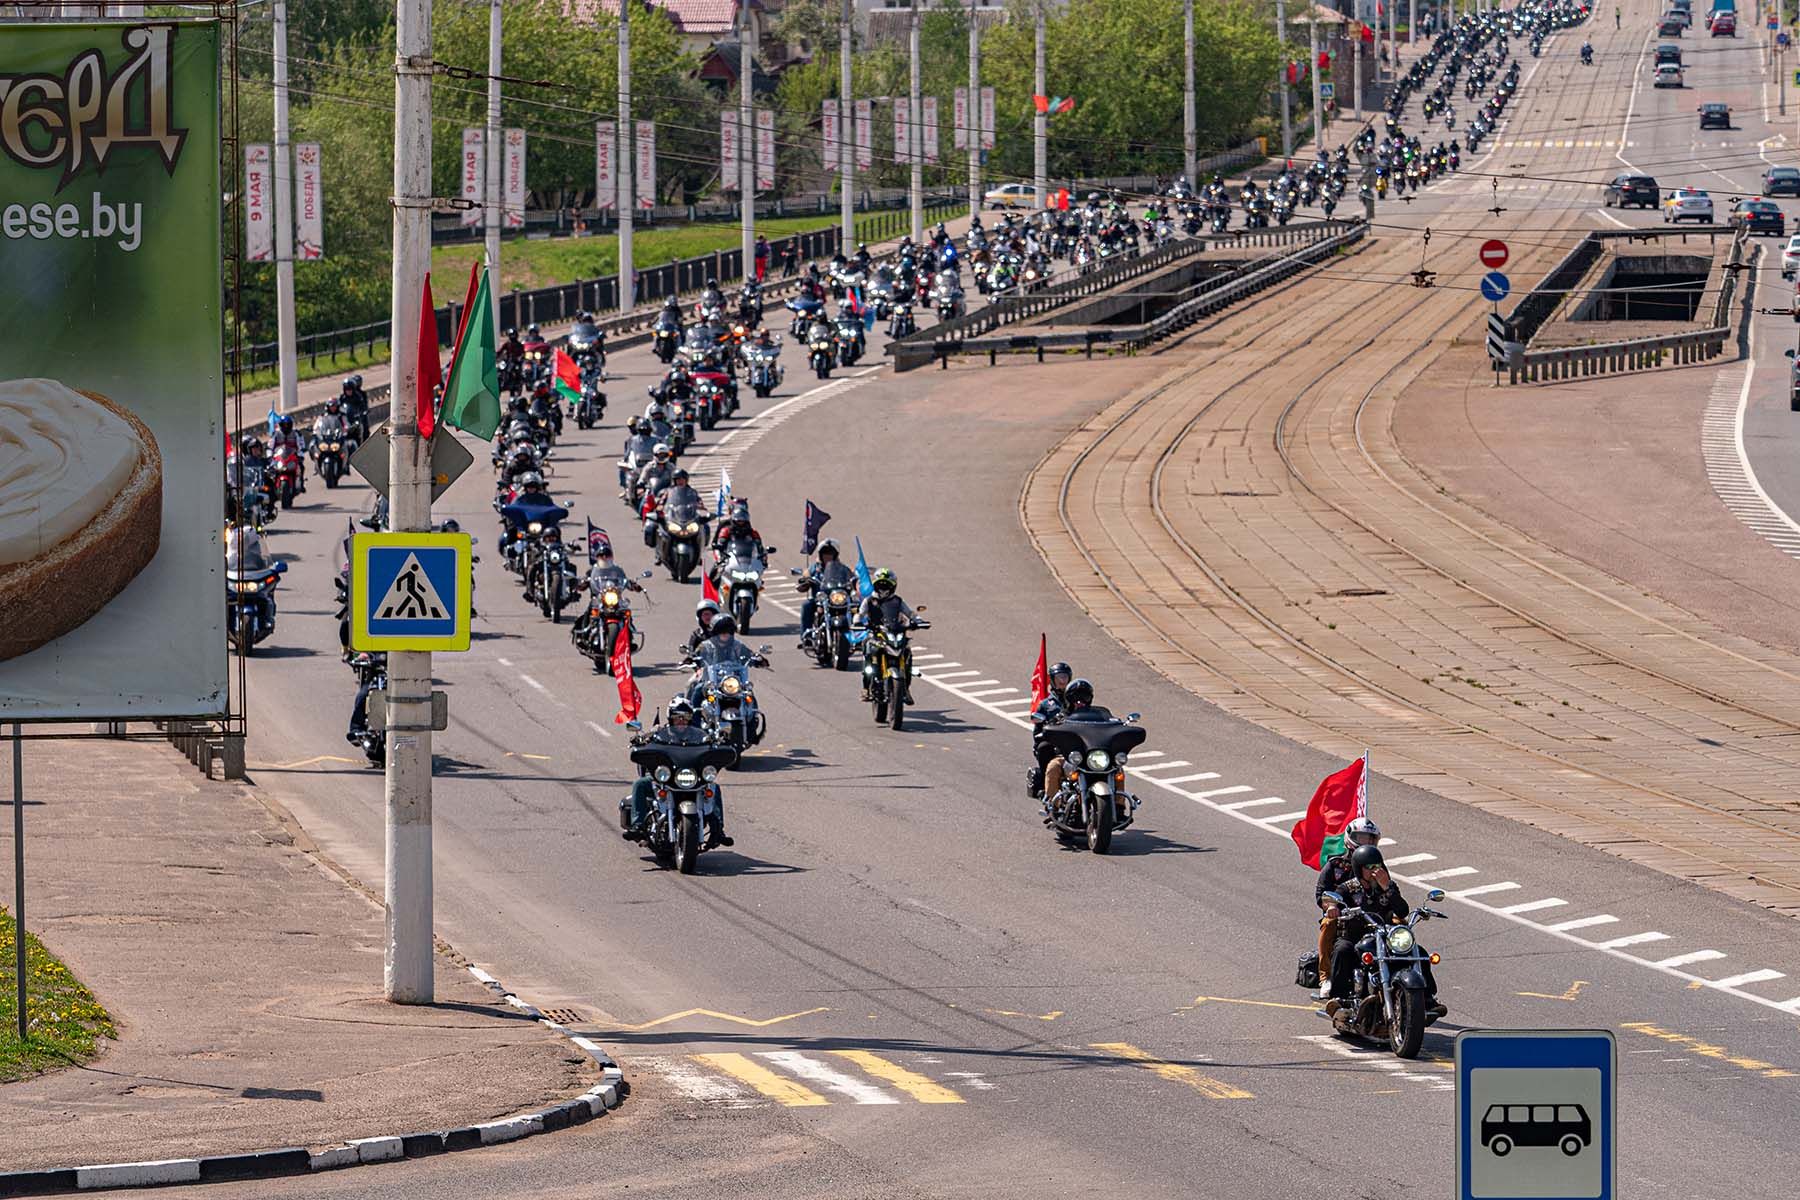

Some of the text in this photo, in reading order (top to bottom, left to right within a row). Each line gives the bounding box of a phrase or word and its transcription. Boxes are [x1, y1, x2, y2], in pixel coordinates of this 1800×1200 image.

[466, 152, 476, 193] 9 МАЯ
[600, 143, 608, 168] МАЯ
[250, 172, 262, 221] 9 МАЯ
[304, 170, 314, 220] ПОБЕДА!
[0, 191, 142, 252] ese.by
